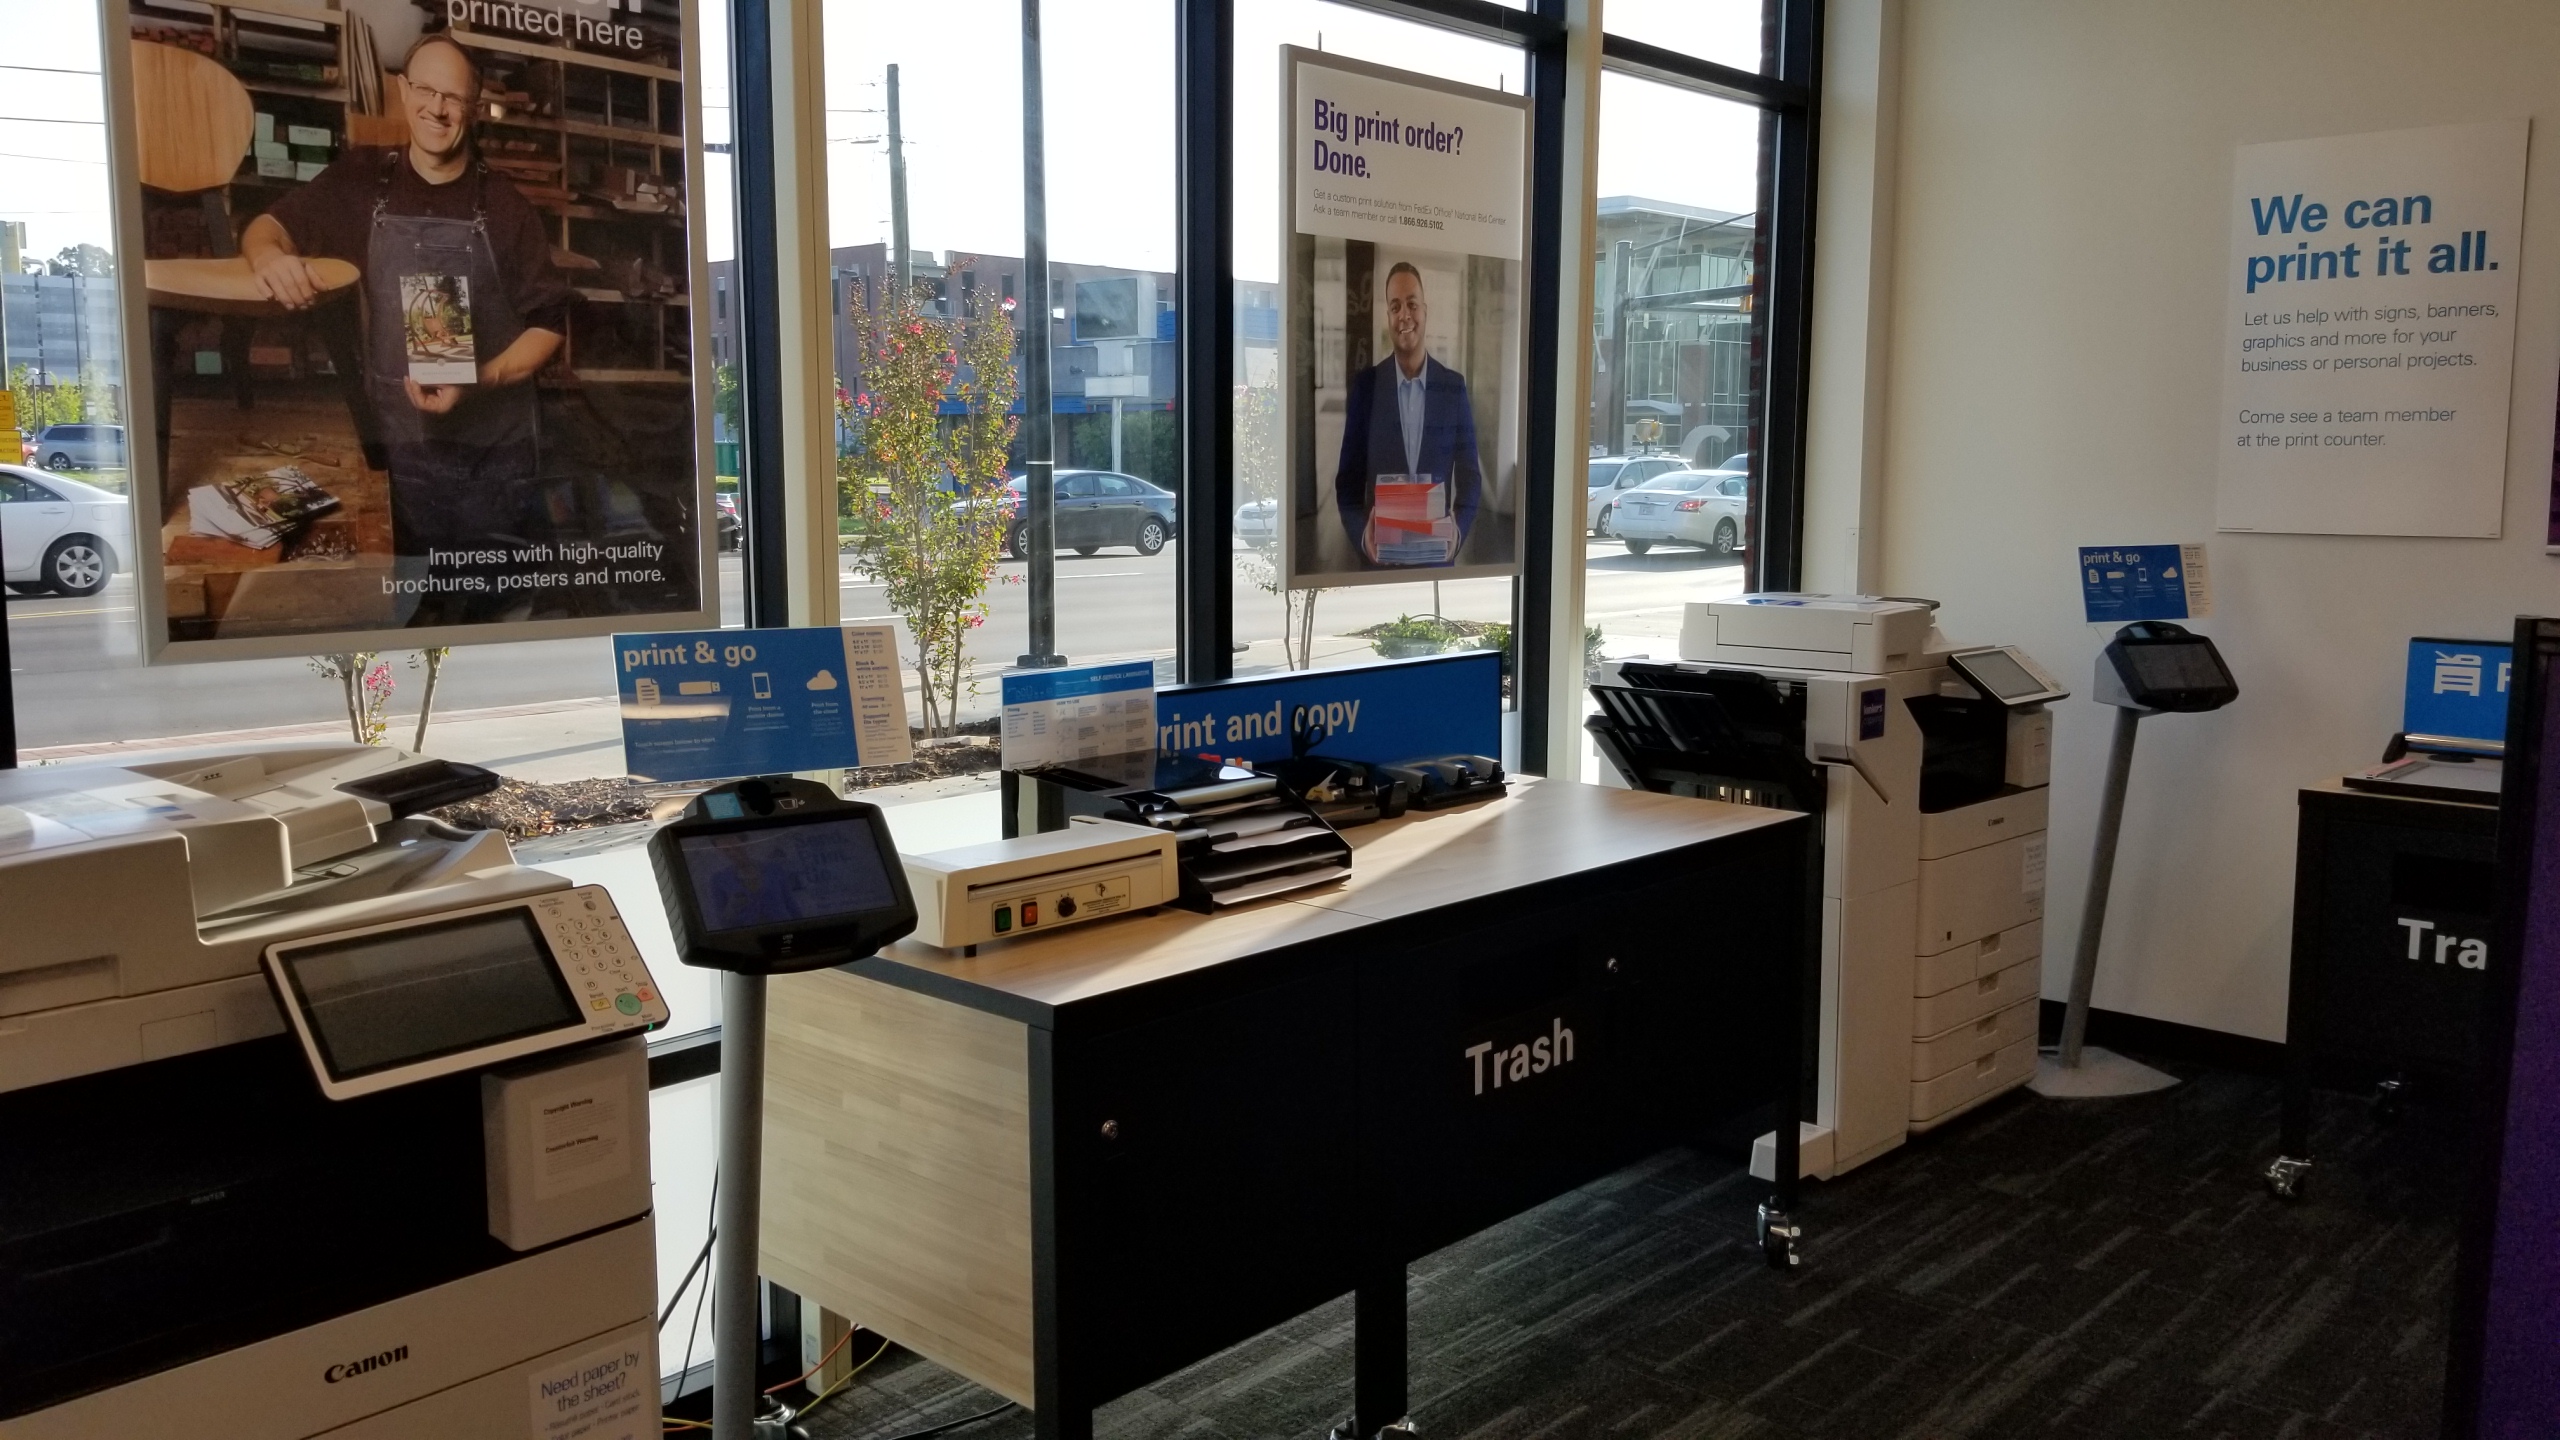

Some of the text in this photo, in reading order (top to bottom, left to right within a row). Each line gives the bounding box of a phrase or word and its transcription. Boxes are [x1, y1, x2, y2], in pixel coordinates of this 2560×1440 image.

[447, 0, 643, 49] printed here
[1314, 99, 1464, 155] Big print order?
[1314, 140, 1371, 178] Done.
[1313, 188, 1326, 200] Get
[1333, 193, 1358, 204] custom
[1358, 196, 1373, 206] print
[1374, 197, 1397, 210] solution
[1399, 201, 1413, 212] from
[1413, 203, 1432, 215] FedEx
[1454, 209, 1476, 221] National
[1313, 204, 1326, 214] Ask
[1333, 207, 1349, 217] team
[1351, 210, 1378, 221] member
[1379, 214, 1386, 222] or
[1387, 215, 1398, 224] call
[2251, 194, 2432, 235] We can
[2247, 230, 2499, 294] print it all.
[2244, 303, 2500, 326] Let us help with signs, banners,
[2242, 328, 2457, 352] graphics and more for your
[2241, 352, 2478, 373] business or personal projects.
[2239, 407, 2457, 424] Come see a team member
[2237, 432, 2386, 449] at the print counter.
[430, 541, 663, 568] Impress with high-quality
[2083, 551, 2140, 566] print & go
[382, 567, 666, 594] brochures, posters and more.
[623, 640, 757, 672] print & go
[1158, 699, 1361, 752] rint and copy
[1465, 1017, 1574, 1096] Trash
[324, 1344, 409, 1384] Canon
[541, 1351, 640, 1399] Need paper by
[557, 1371, 626, 1412] the sheet?
